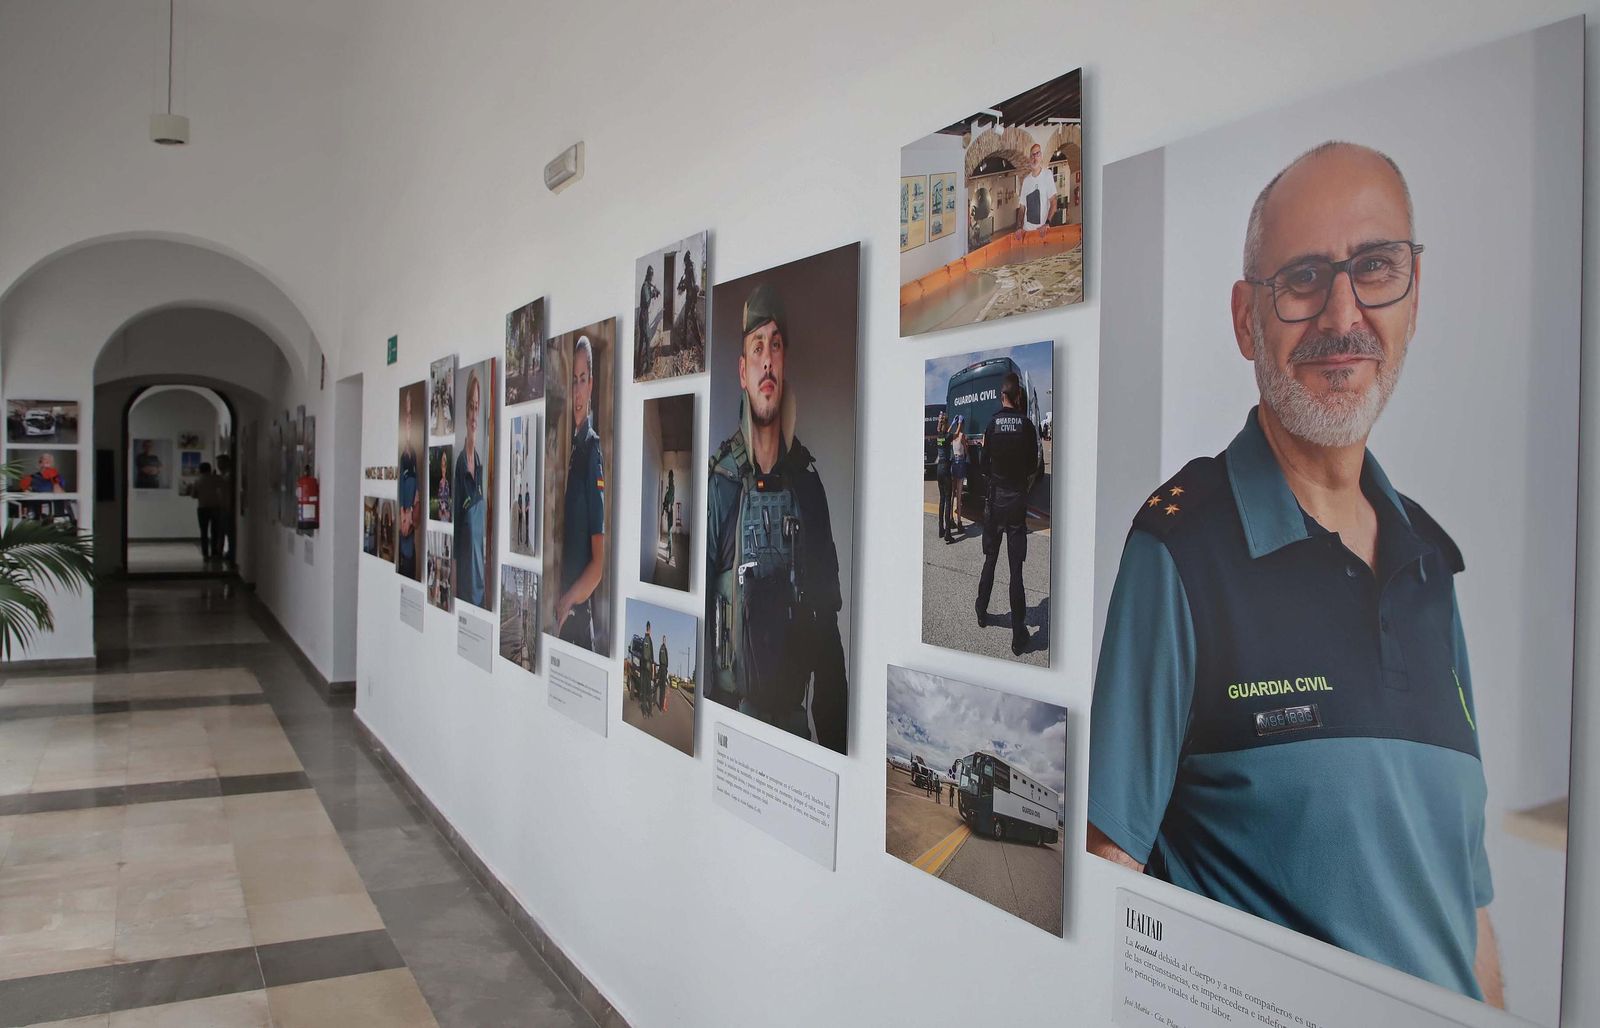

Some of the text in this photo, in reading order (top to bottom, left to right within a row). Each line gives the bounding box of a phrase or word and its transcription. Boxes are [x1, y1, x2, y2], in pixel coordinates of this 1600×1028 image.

[954, 389, 997, 406] GUARDIA CIVIL
[1228, 676, 1333, 699] GUARDIA CIVIL
[1126, 907, 1163, 941] LEALTAD
[1124, 950, 1133, 959] de
[1133, 953, 1142, 965] las
[1144, 959, 1191, 989] circunstancias,
[1191, 983, 1200, 993] es
[1200, 984, 1249, 1015] imperecedera
[1250, 1010, 1256, 1018] e
[1124, 962, 1233, 1022] los principios vitales de mi labor.
[1125, 936, 1134, 946] La
[1134, 941, 1158, 958] lealtad
[1158, 951, 1180, 969] debida
[1181, 963, 1188, 972] al
[1189, 965, 1216, 985] Cuerpo
[1217, 980, 1222, 990] y
[1229, 984, 1243, 997] mis
[1244, 993, 1293, 1020] compañeros
[1294, 1015, 1304, 1025] es
